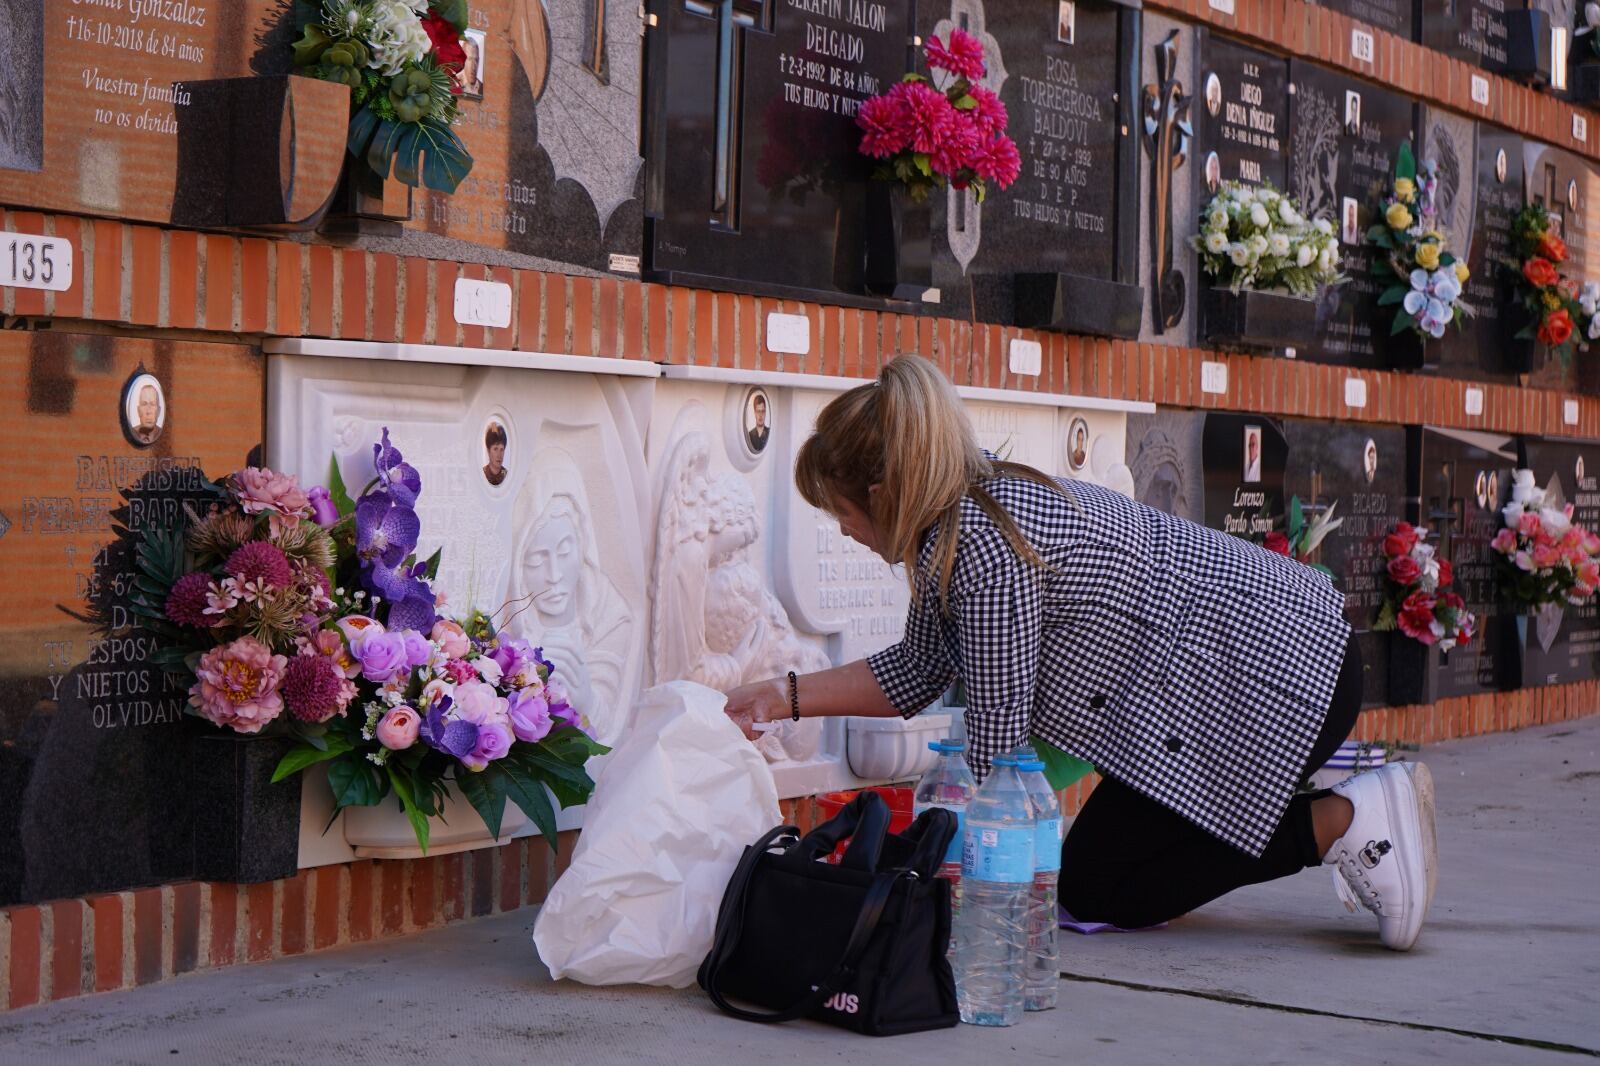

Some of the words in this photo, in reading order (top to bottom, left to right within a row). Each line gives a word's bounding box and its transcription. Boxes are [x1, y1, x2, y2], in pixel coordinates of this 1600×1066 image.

[788, 0, 842, 20] AFIN
[846, 0, 886, 33] JALON
[76, 17, 144, 51] 16-10-2018
[145, 28, 158, 55] de
[160, 34, 177, 58] 84
[178, 38, 205, 63] años
[805, 22, 865, 64] DELGADO
[82, 68, 138, 97] Vuestra
[140, 77, 192, 107] familia
[788, 56, 826, 83] 2-3-1992
[830, 66, 842, 87] DE
[844, 71, 855, 90] 84
[857, 72, 880, 97] AÑOS
[1046, 55, 1079, 88] ROSA
[784, 82, 801, 105] TUS
[803, 87, 830, 110] HIJOS
[832, 94, 840, 114] Y
[1020, 75, 1102, 122] TORREGROSA
[1240, 82, 1262, 106] DIEGO
[94, 106, 113, 125] no
[116, 112, 131, 127] os
[135, 107, 178, 135] olvida
[1034, 108, 1089, 146] BALDOVI
[1034, 159, 1045, 178] DE
[1049, 162, 1060, 181] 90
[1064, 164, 1087, 187] AÑOS
[1239, 158, 1261, 183] MARIA
[503, 179, 537, 206] años
[1013, 198, 1031, 219] TUS
[1034, 203, 1060, 225] HIJOS
[1064, 209, 1071, 227] Y
[1075, 211, 1105, 233] NIETOS
[8, 240, 54, 284] 135
[76, 454, 205, 493] BAUTISTA
[1233, 486, 1265, 507] Lorenzo
[1352, 494, 1387, 514] RICARDO
[1224, 510, 1247, 533] Pardo
[1249, 511, 1274, 535] Simón
[44, 640, 73, 668] TU
[87, 636, 159, 666] ESPOSA
[47, 675, 65, 701] Y
[77, 669, 150, 700] NIETOS
[92, 697, 183, 729] OLVIDAN
[816, 988, 859, 1014] US
